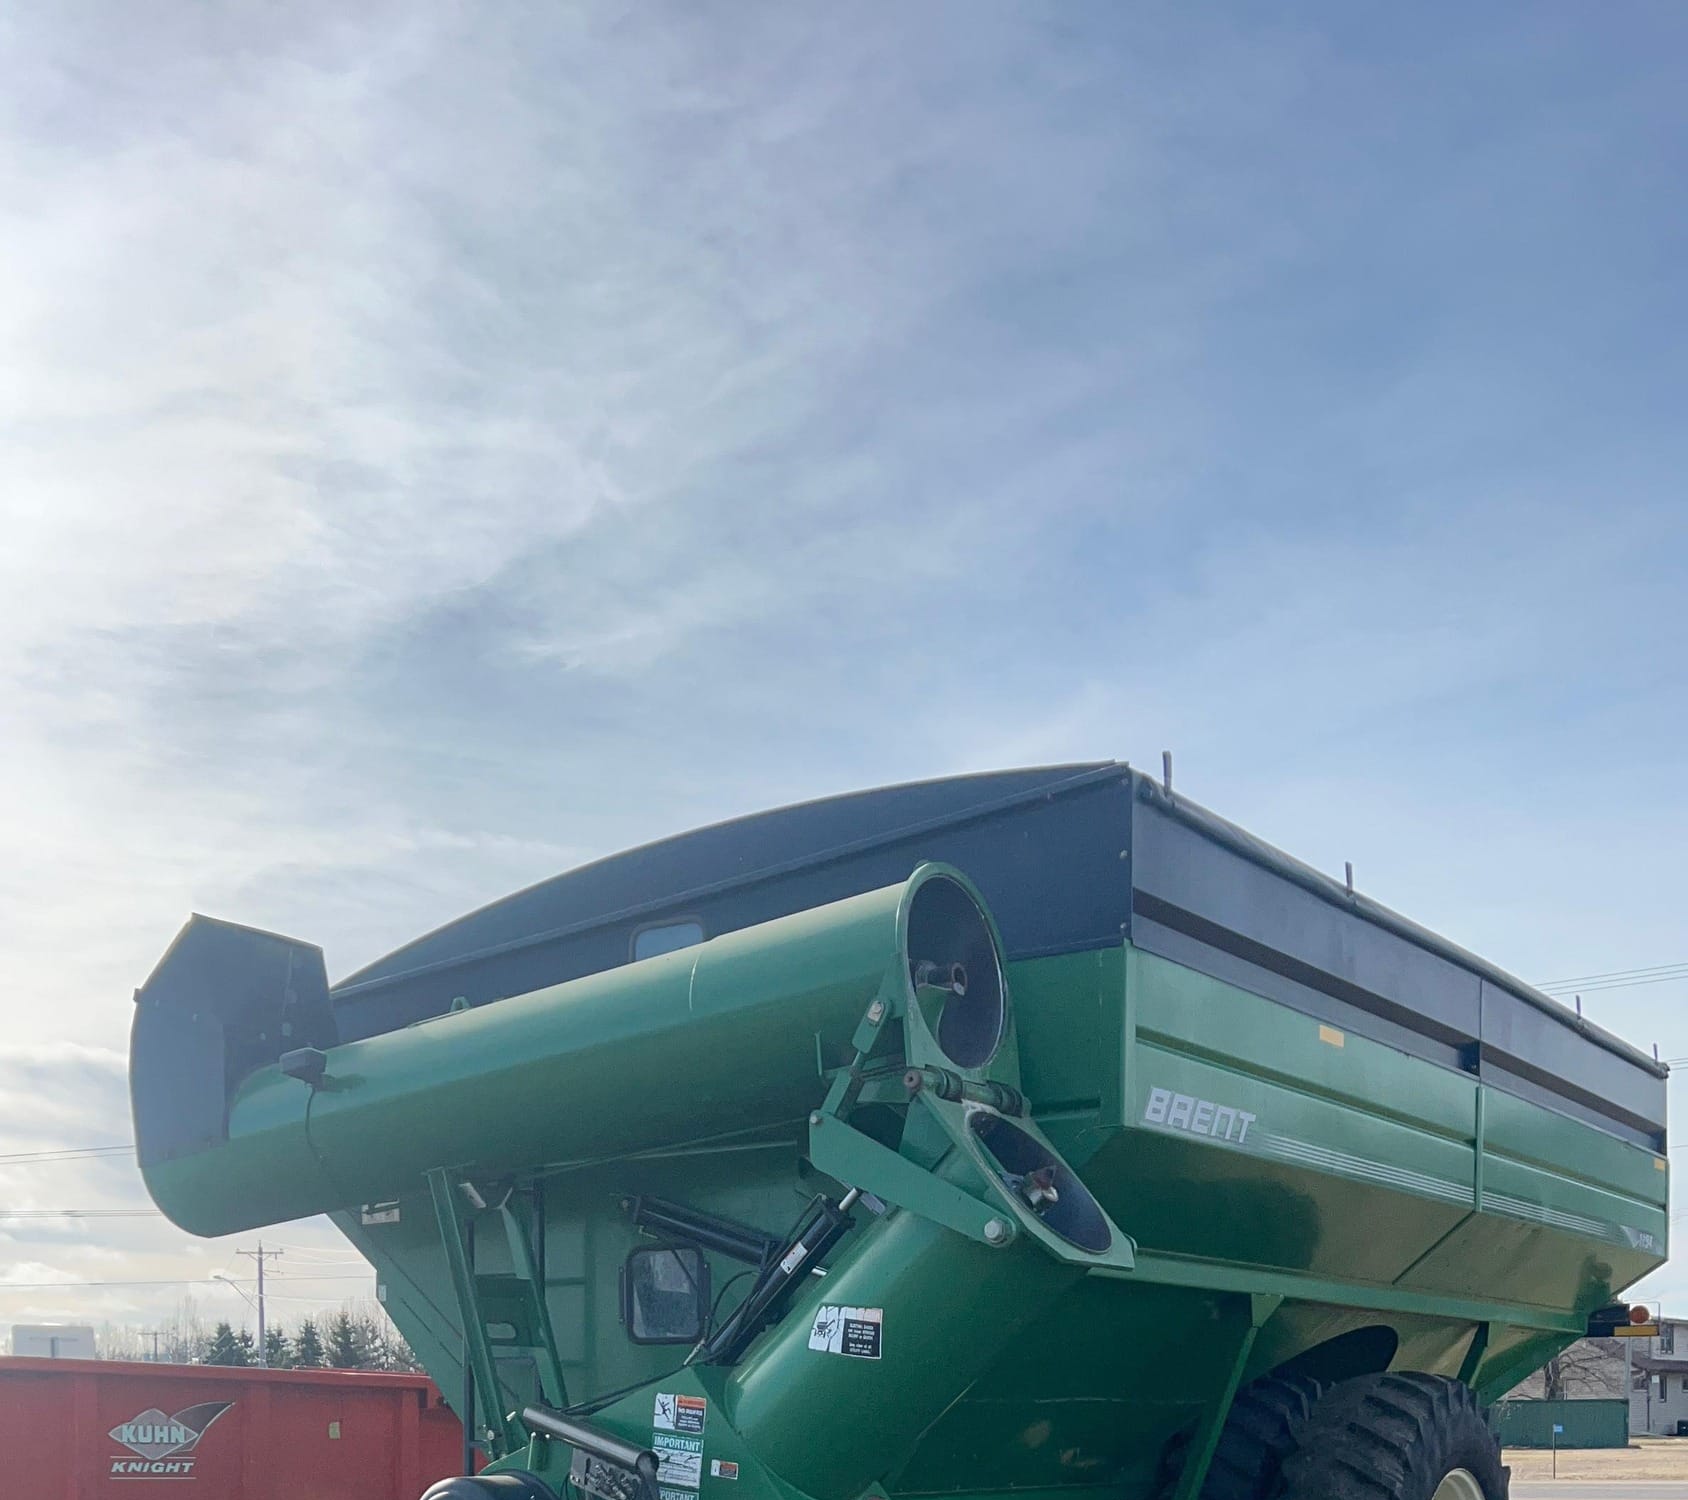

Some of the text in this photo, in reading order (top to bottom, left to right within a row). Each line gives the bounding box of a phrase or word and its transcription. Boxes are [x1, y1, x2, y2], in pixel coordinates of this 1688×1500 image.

[1145, 1086, 1257, 1144] BRENT
[122, 1423, 185, 1444] KUHN
[654, 1435, 701, 1452] IMPORTANT
[111, 1461, 195, 1473] KNIGHT
